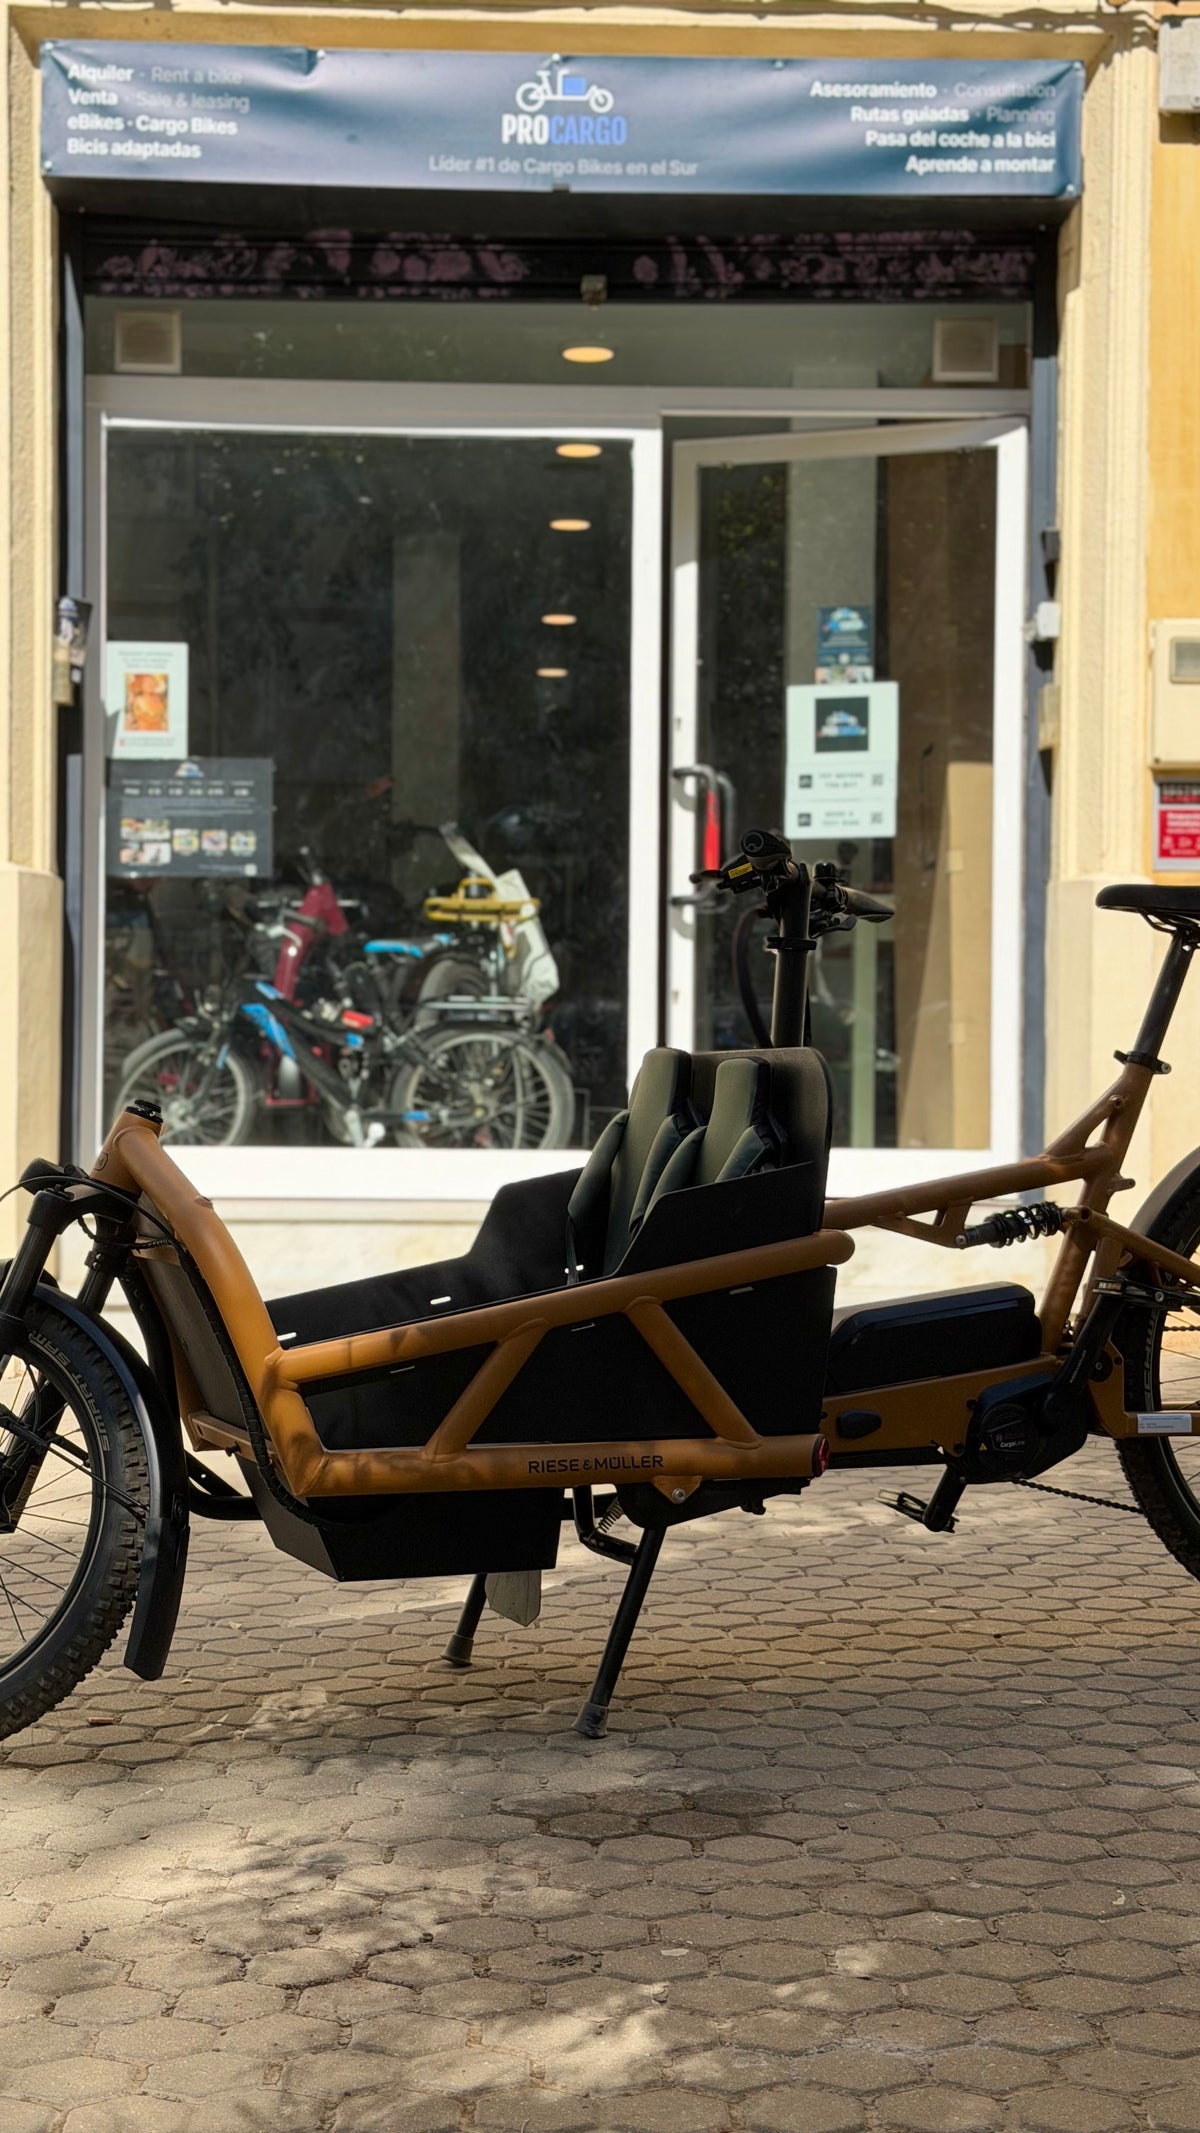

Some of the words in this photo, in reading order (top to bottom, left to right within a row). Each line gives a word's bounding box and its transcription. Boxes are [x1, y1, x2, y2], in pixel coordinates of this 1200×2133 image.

[68, 63, 134, 84] Alquiler
[151, 66, 189, 83] Rent
[67, 89, 118, 105] Venta
[810, 81, 938, 98] Asesoramiento
[67, 116, 124, 131] eBikes
[136, 116, 188, 136] Cargo
[191, 118, 238, 135] Bikes
[850, 106, 899, 122] Rutas
[902, 106, 970, 126] guiadas
[67, 138, 108, 155] Bicis
[111, 139, 201, 159] adaptadas
[866, 130, 906, 147] Pasa
[909, 131, 936, 147] del
[938, 131, 990, 148] coche
[992, 135, 1004, 148] a
[1007, 132, 1022, 148] la
[1025, 131, 1056, 148] bici
[475, 156, 495, 172] #1
[499, 156, 520, 174] de
[523, 158, 575, 177] Cargo
[577, 159, 623, 175] Bikes
[626, 162, 647, 176] en
[651, 160, 666, 176] el
[669, 160, 698, 176] Sur
[905, 155, 978, 175] Aprende
[981, 161, 992, 173] a
[994, 156, 1056, 173] montar
[528, 1459, 579, 1474] RIESE
[583, 1460, 592, 1470] &
[594, 1455, 664, 1470] MÜLLER
